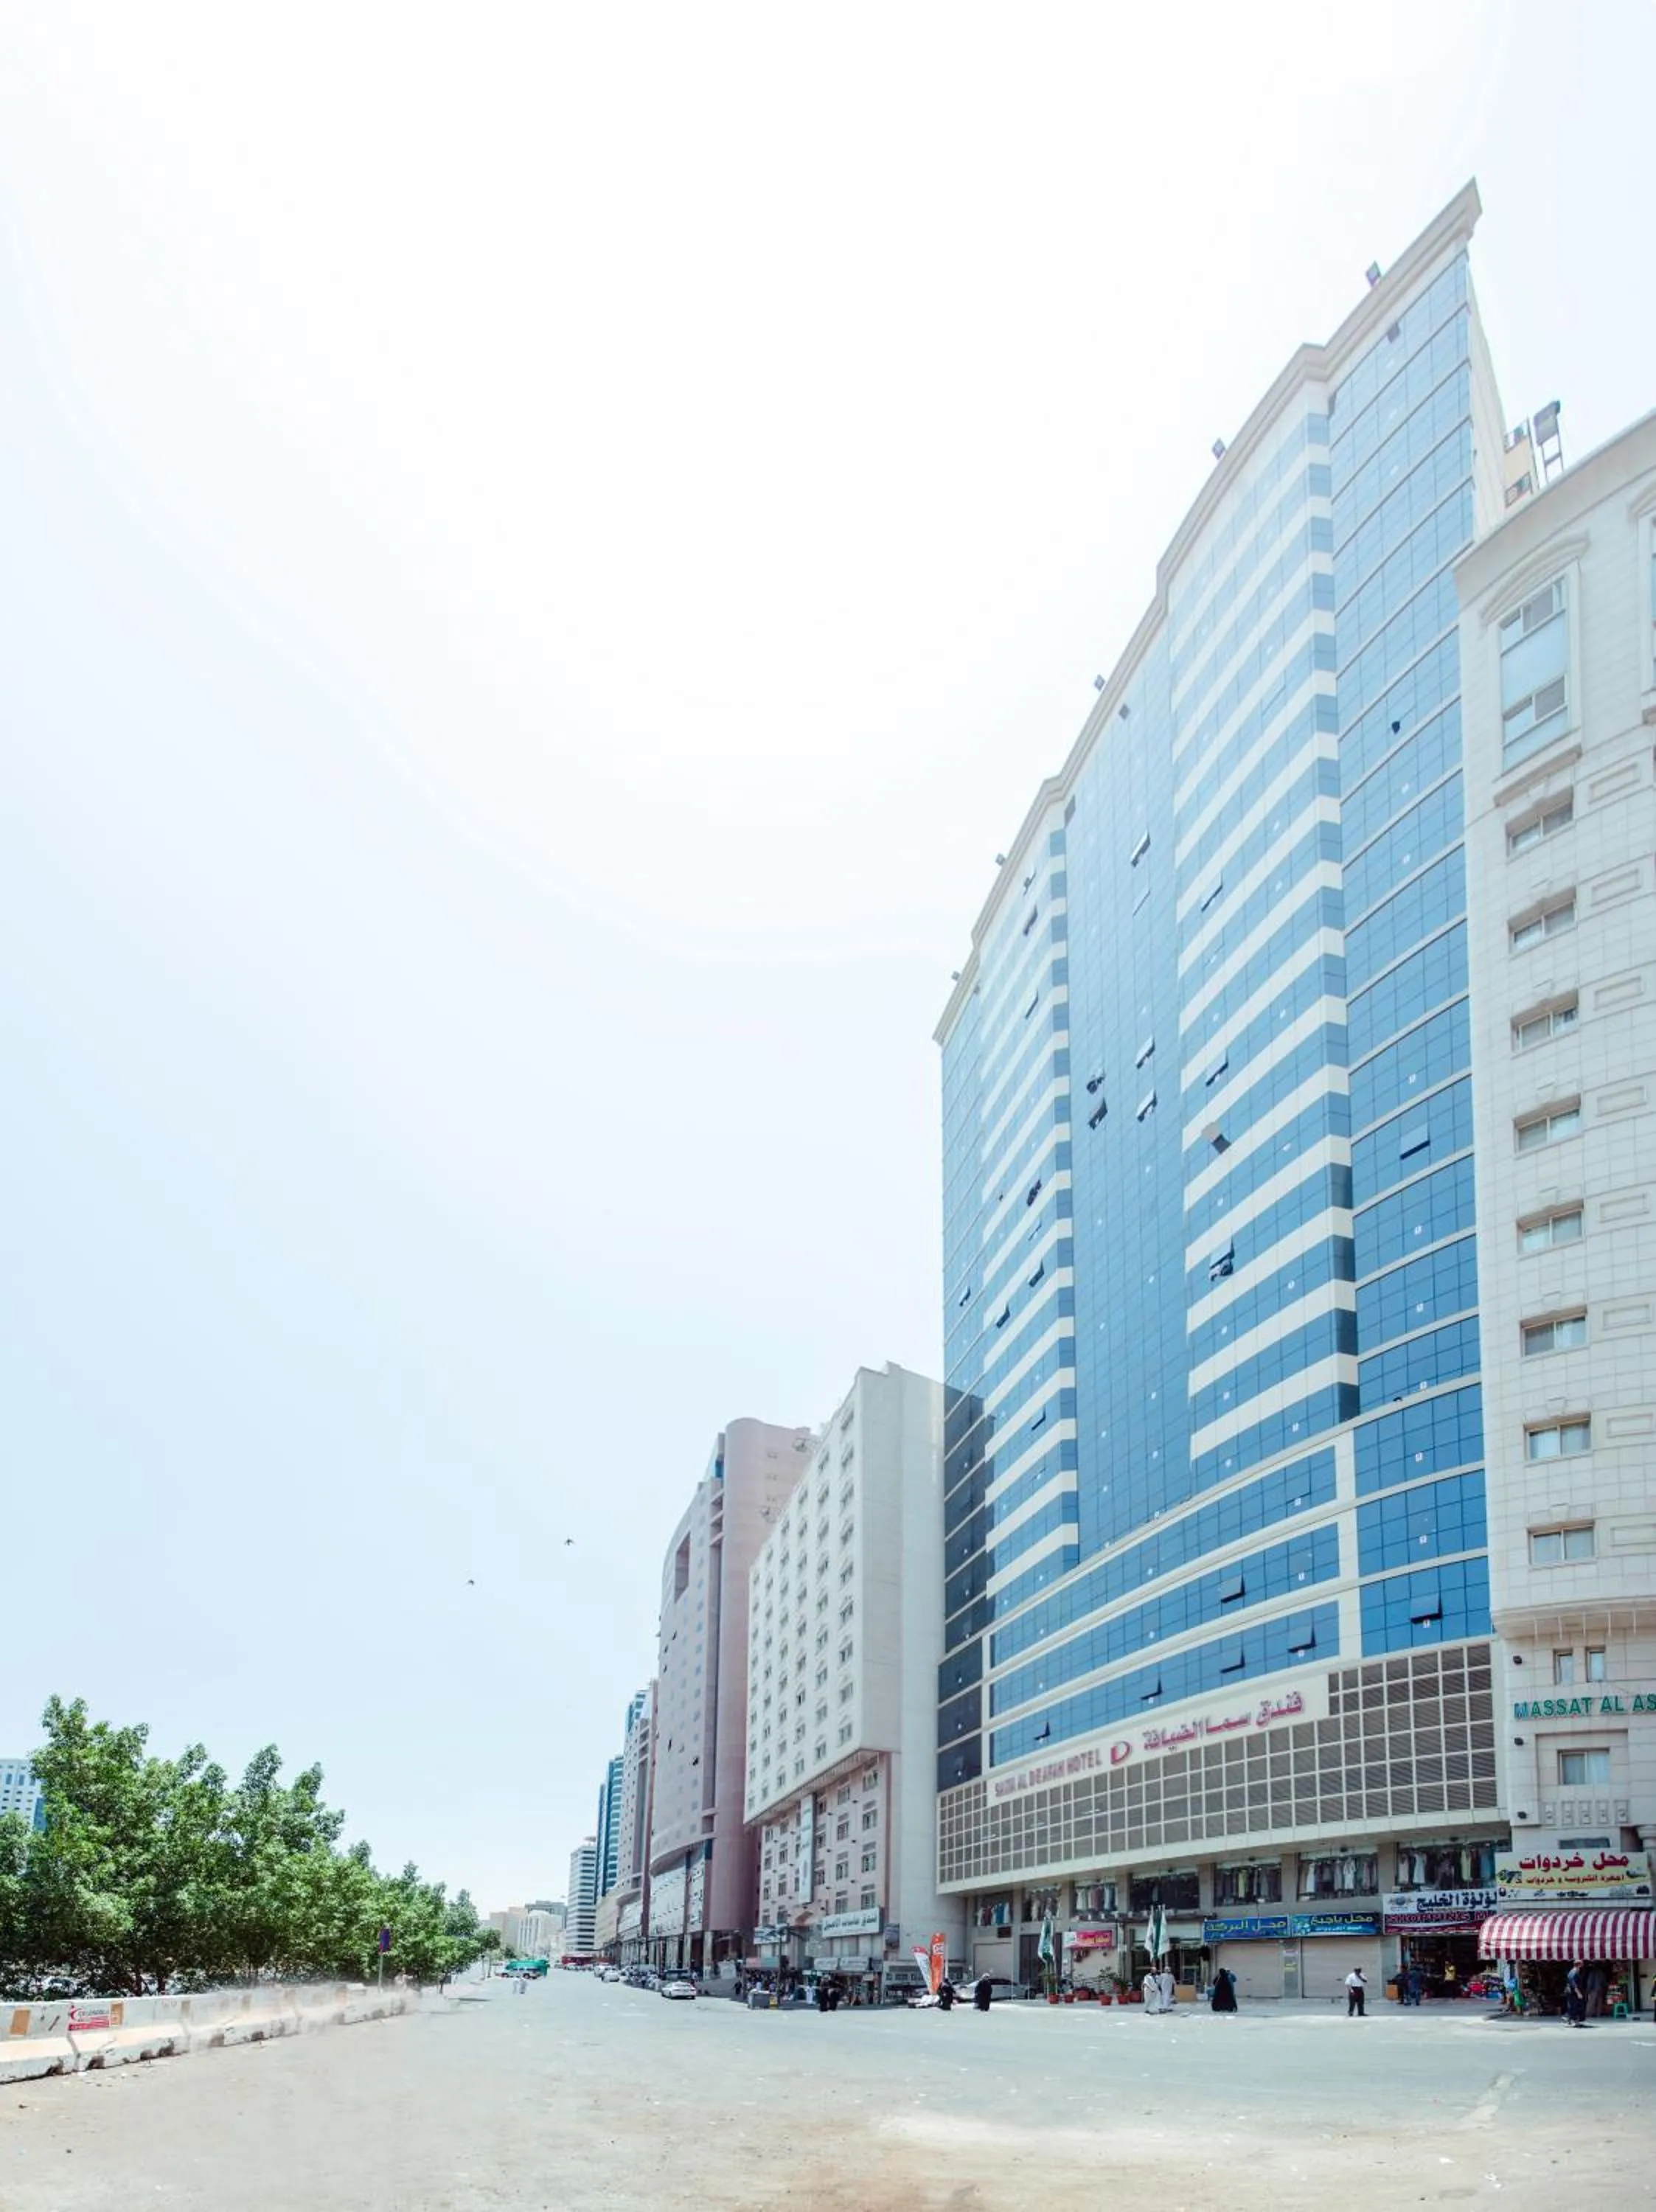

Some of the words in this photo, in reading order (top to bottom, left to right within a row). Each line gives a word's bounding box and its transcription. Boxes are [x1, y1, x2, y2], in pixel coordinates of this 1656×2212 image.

[1256, 1690, 1304, 1728] فندق
[1514, 1697, 1593, 1720] MASSAT
[1601, 1695, 1624, 1712] AL
[1067, 1748, 1102, 1774] HOTEL
[1519, 1851, 1584, 1871] خردوات
[1592, 1851, 1629, 1871] محل
[1416, 1893, 1459, 1912] الخليج
[1462, 1890, 1497, 1909] لؤلؤة
[1252, 1919, 1287, 1932] محل
[1344, 1913, 1374, 1924] محل
